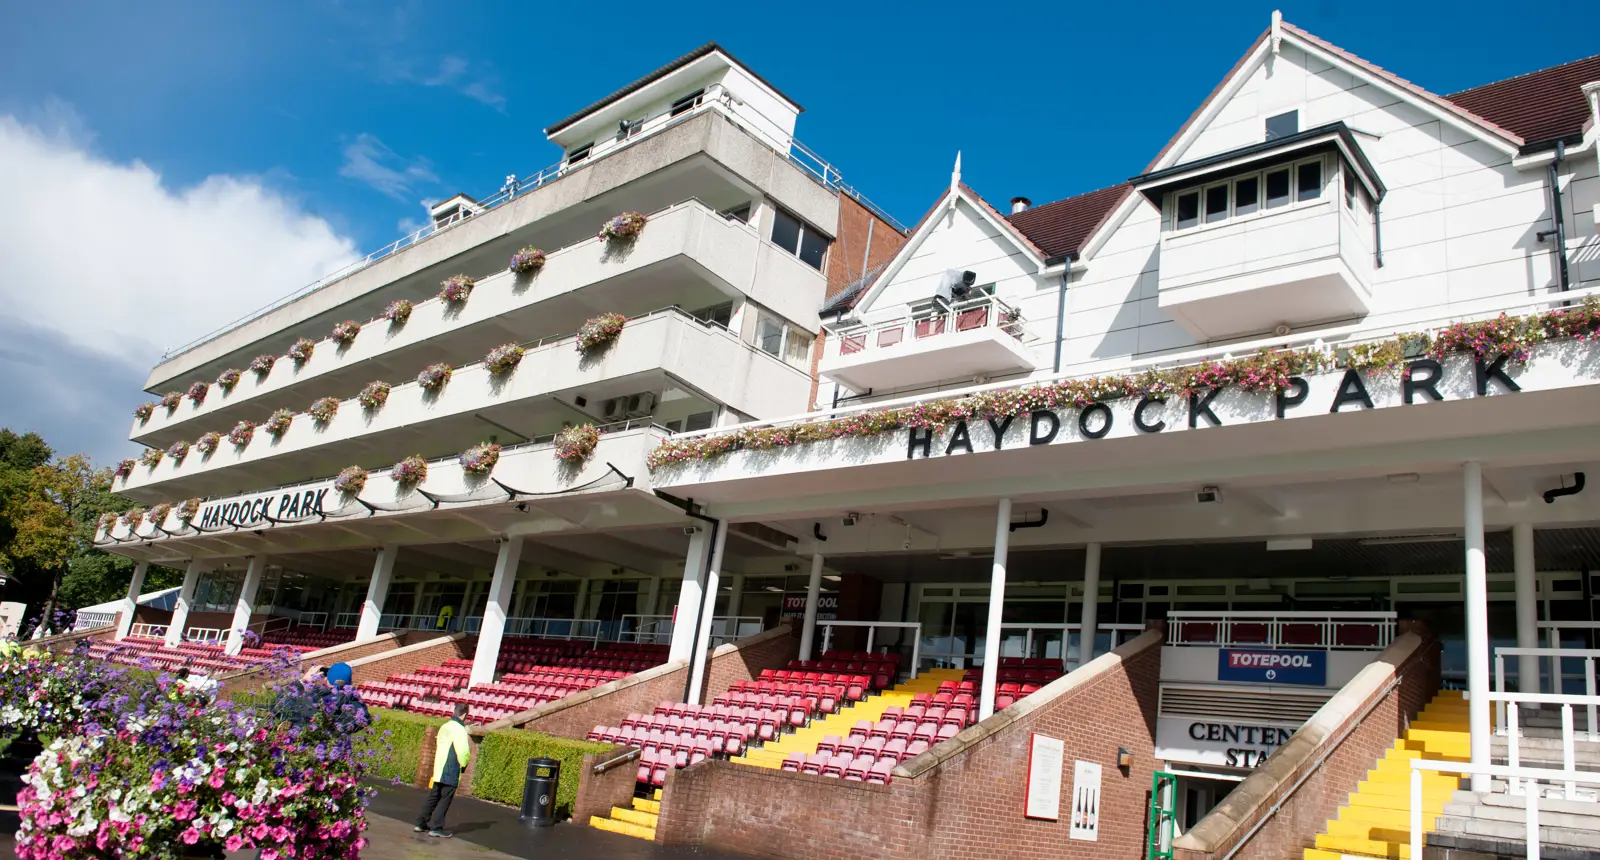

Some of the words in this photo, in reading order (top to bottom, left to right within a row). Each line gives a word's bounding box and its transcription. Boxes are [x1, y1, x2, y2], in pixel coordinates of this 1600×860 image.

[906, 388, 1223, 459] HAYDOCK
[1276, 352, 1522, 419] PARK
[200, 497, 275, 528] HAYDOCK
[278, 488, 330, 520] PARK
[787, 598, 838, 608] TOTOOL
[1231, 653, 1312, 668] TOTEPOOL
